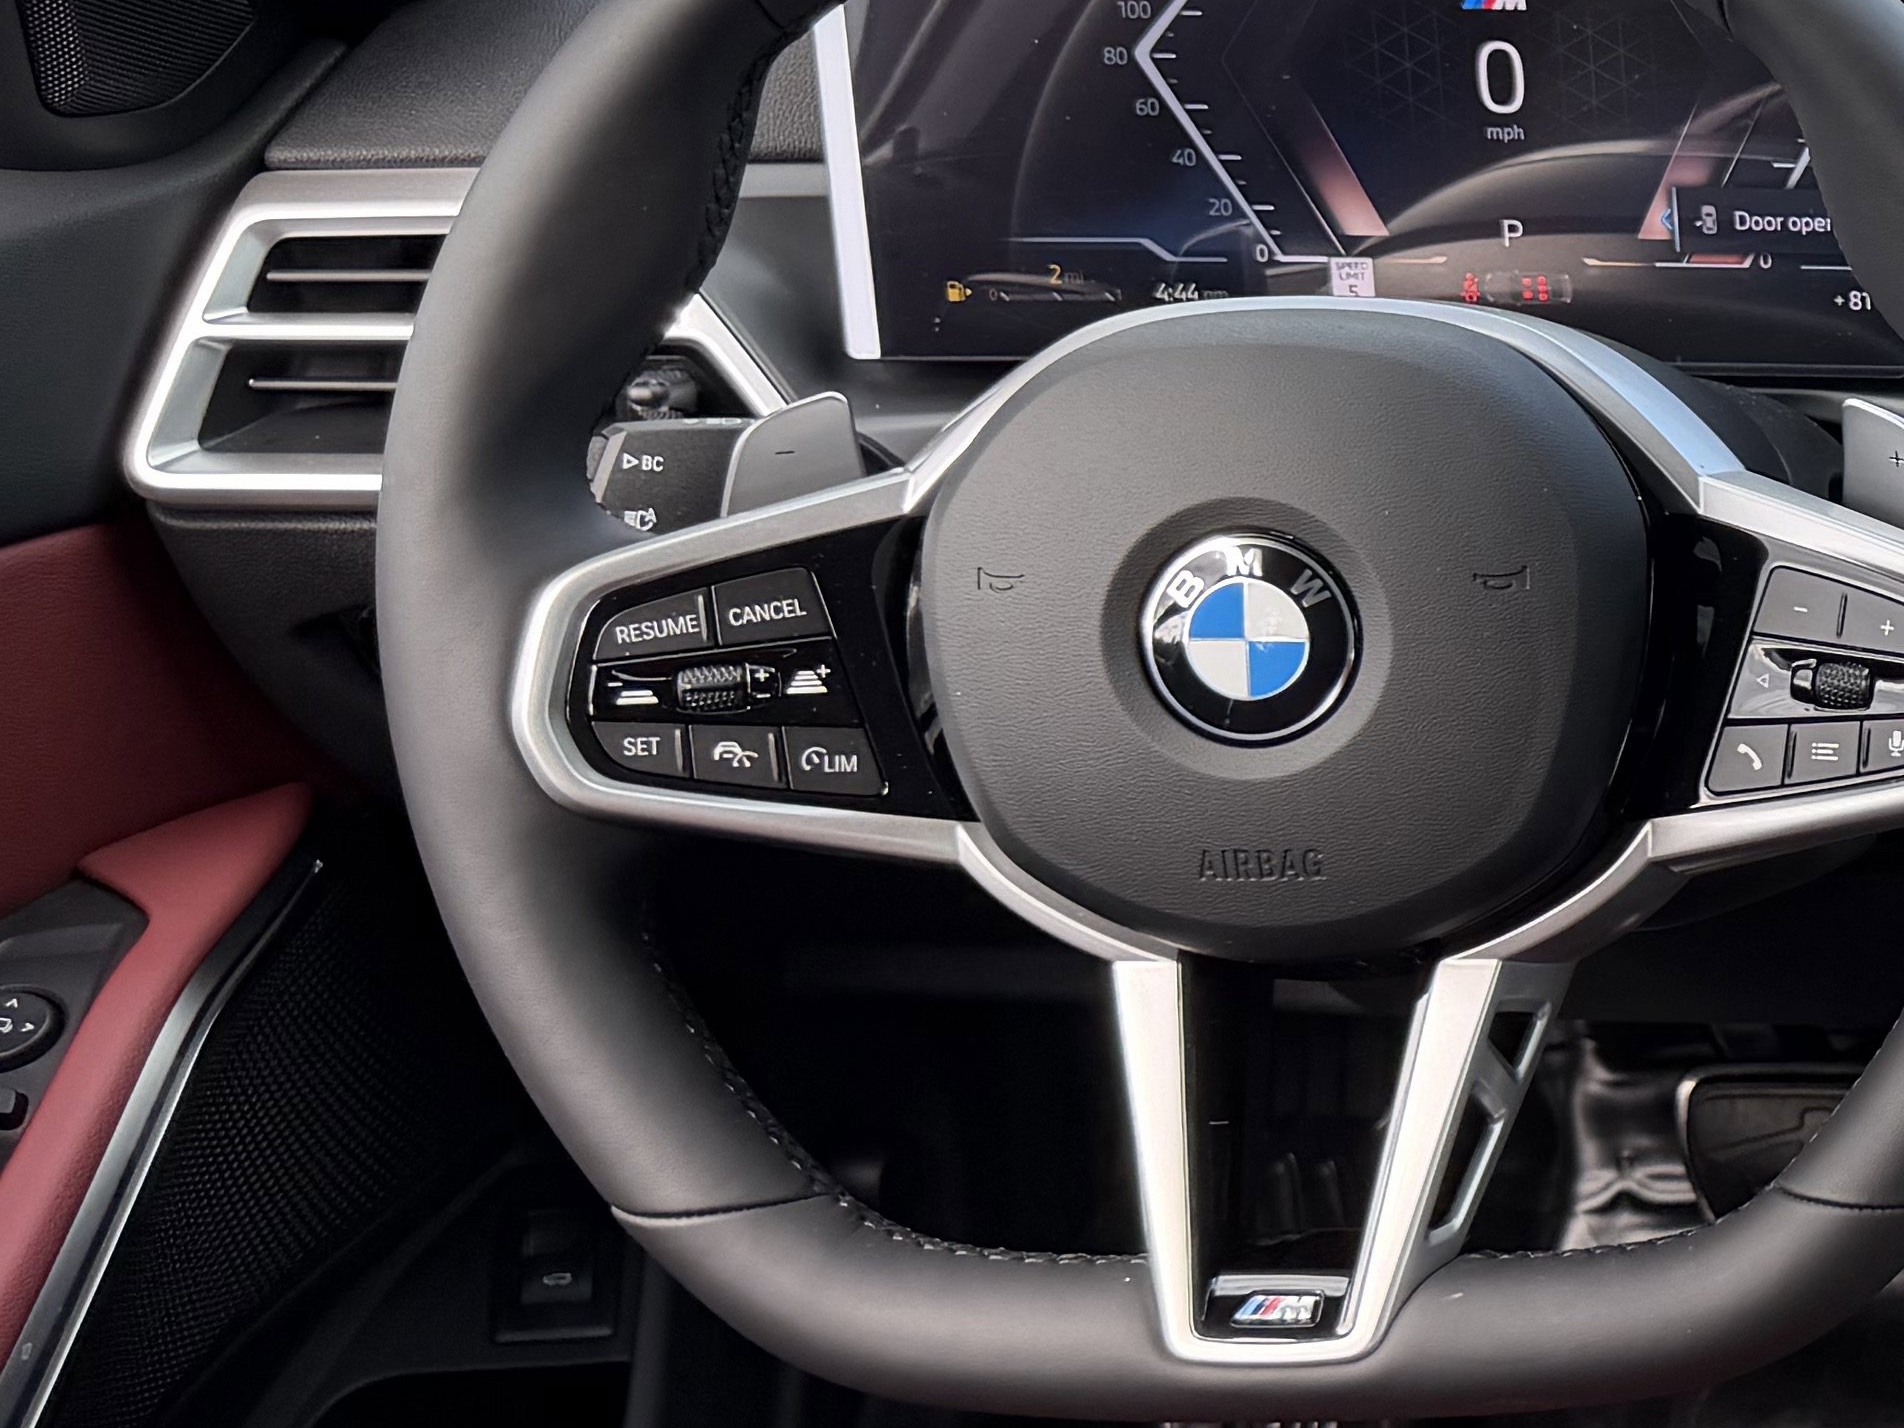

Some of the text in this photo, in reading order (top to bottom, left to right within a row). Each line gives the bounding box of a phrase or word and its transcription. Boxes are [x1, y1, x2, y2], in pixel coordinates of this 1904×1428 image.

[1117, 0, 1152, 19] 100
[1103, 48, 1128, 65] 80
[1475, 40, 1526, 114] 0
[1135, 97, 1160, 116] 60
[1486, 125, 1525, 142] mph
[1171, 148, 1197, 167] 40
[1208, 198, 1233, 217] 20
[1733, 210, 1784, 232] Door
[1501, 218, 1524, 247] P
[1255, 244, 1269, 262] 0
[1048, 263, 1062, 285] 2
[1335, 260, 1369, 271] SPEED
[1338, 272, 1366, 282] LIMIT
[1154, 282, 1199, 303] 4:44
[641, 454, 665, 472] BC
[1166, 545, 1333, 609] BMW
[728, 598, 807, 628] CANCEL
[615, 613, 700, 645] RESUME
[622, 736, 661, 757] SET
[822, 754, 859, 774] LIM
[1199, 848, 1327, 882] AIRBAG
